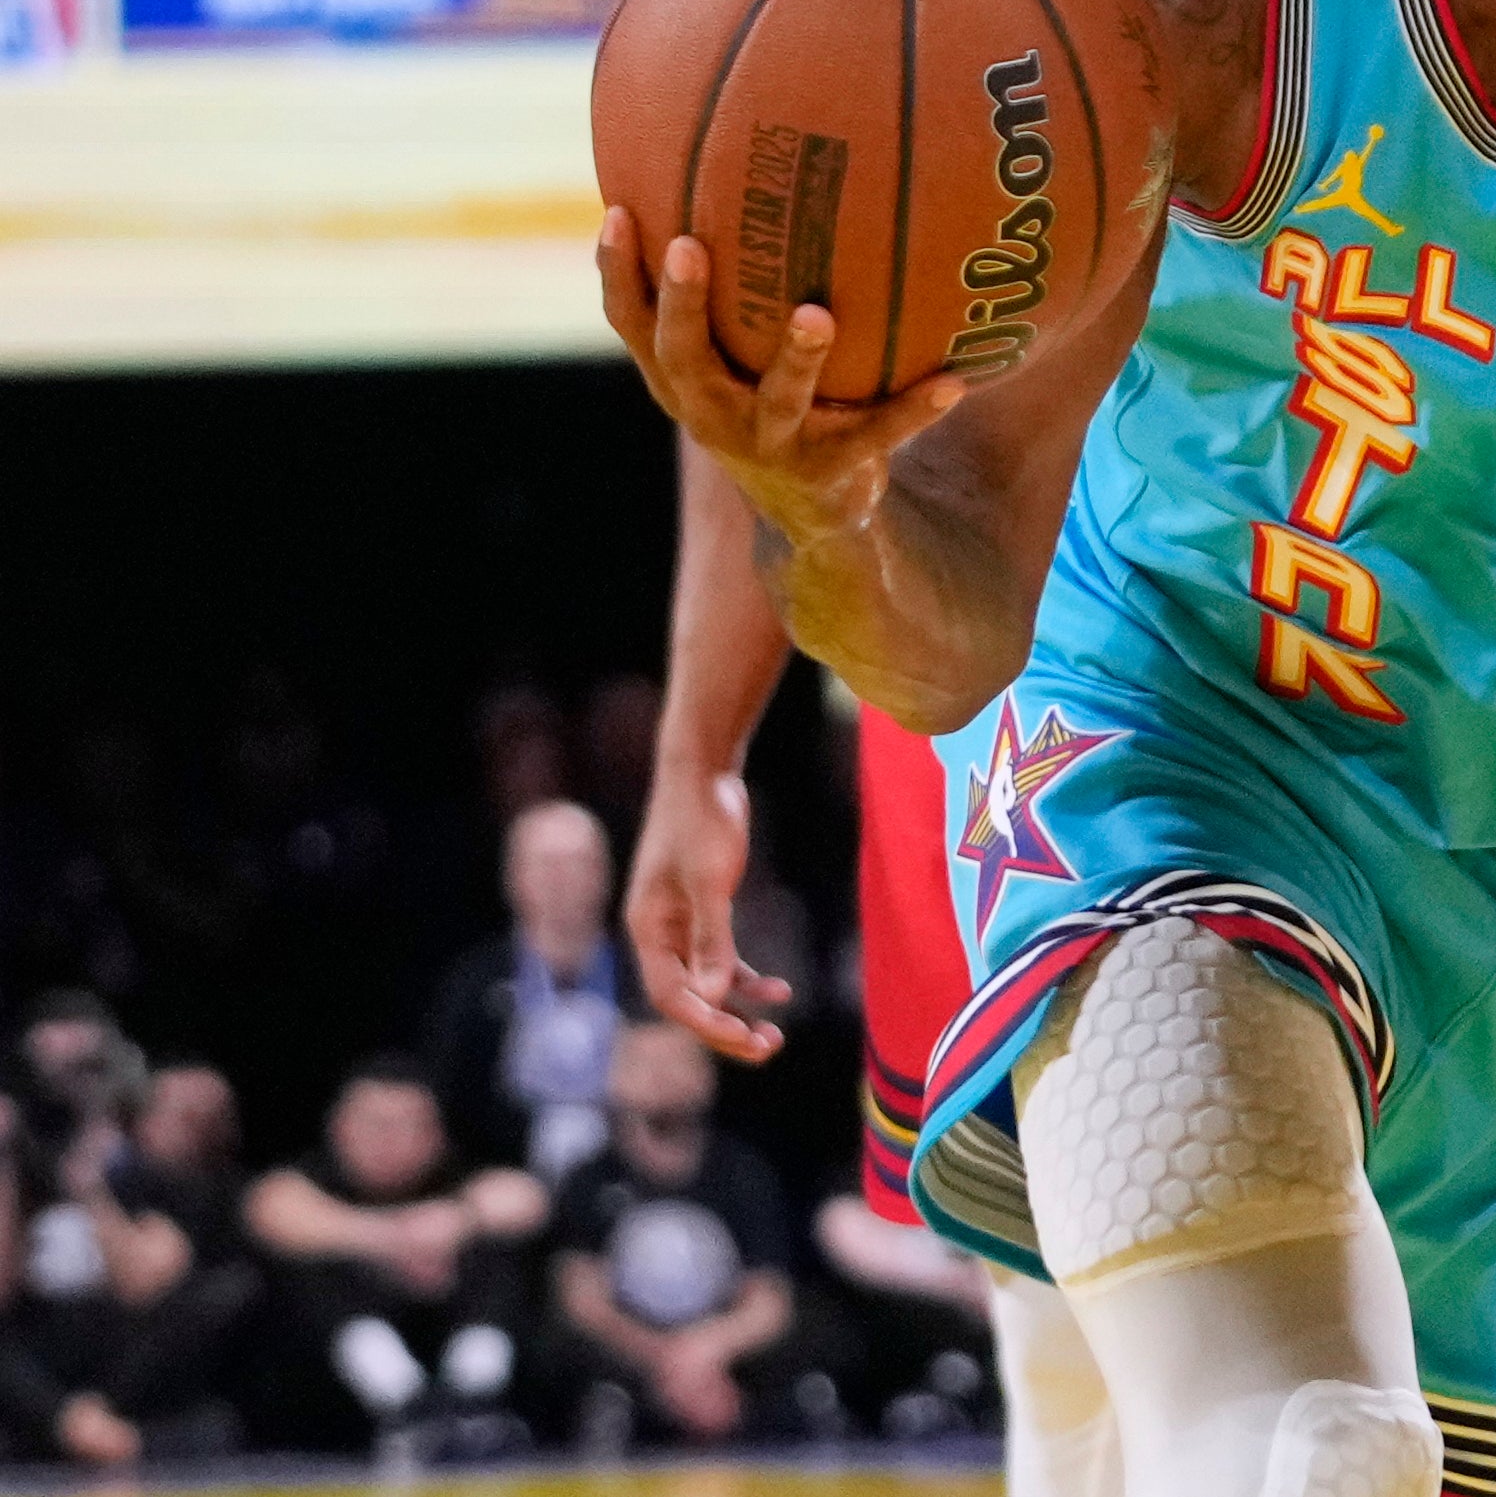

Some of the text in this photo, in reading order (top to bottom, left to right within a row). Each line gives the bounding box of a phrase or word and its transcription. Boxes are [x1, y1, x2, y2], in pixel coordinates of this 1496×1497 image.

[746, 118, 801, 190] 2025
[1259, 225, 1496, 365] ALL
[1249, 310, 1419, 726] STAR
